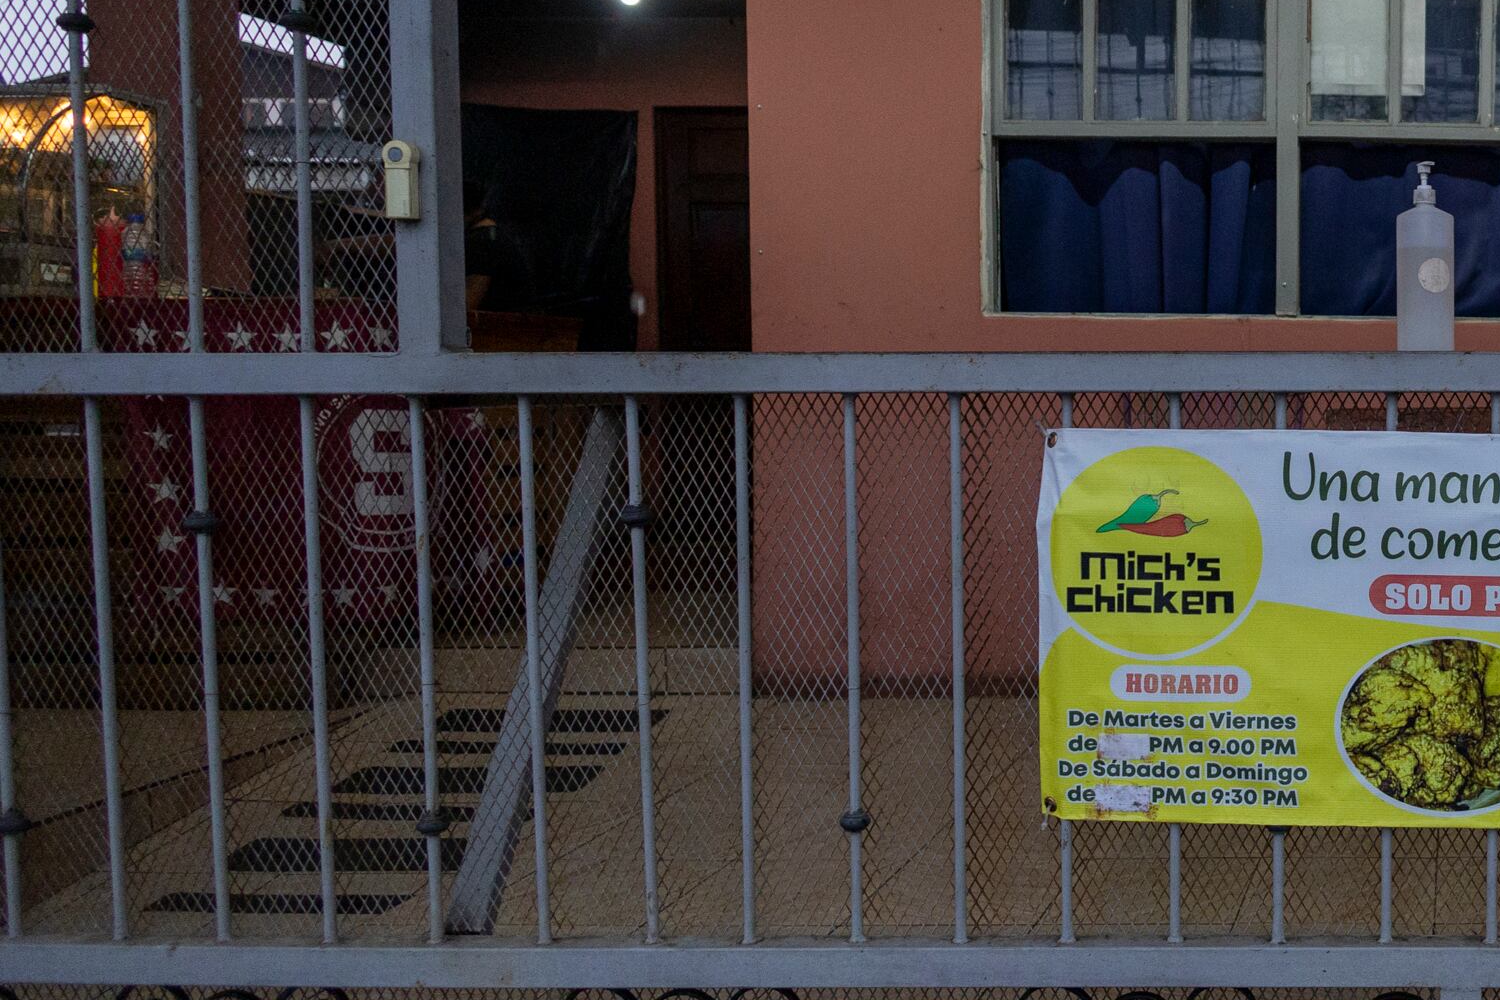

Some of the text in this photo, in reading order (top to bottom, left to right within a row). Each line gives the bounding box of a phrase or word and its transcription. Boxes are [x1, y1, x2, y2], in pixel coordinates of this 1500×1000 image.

[1283, 451, 1380, 502] Una
[1311, 512, 1366, 561] de
[1385, 583, 1470, 612] SOLO
[1125, 672, 1239, 695] HORARIO
[1069, 710, 1296, 730] De Martes a Viernes
[1069, 735, 1296, 755] de PM a 9.00 PM
[1059, 760, 1308, 785] De Sábado a Domingo
[1068, 785, 1297, 806] de PM a 9:30 PM
